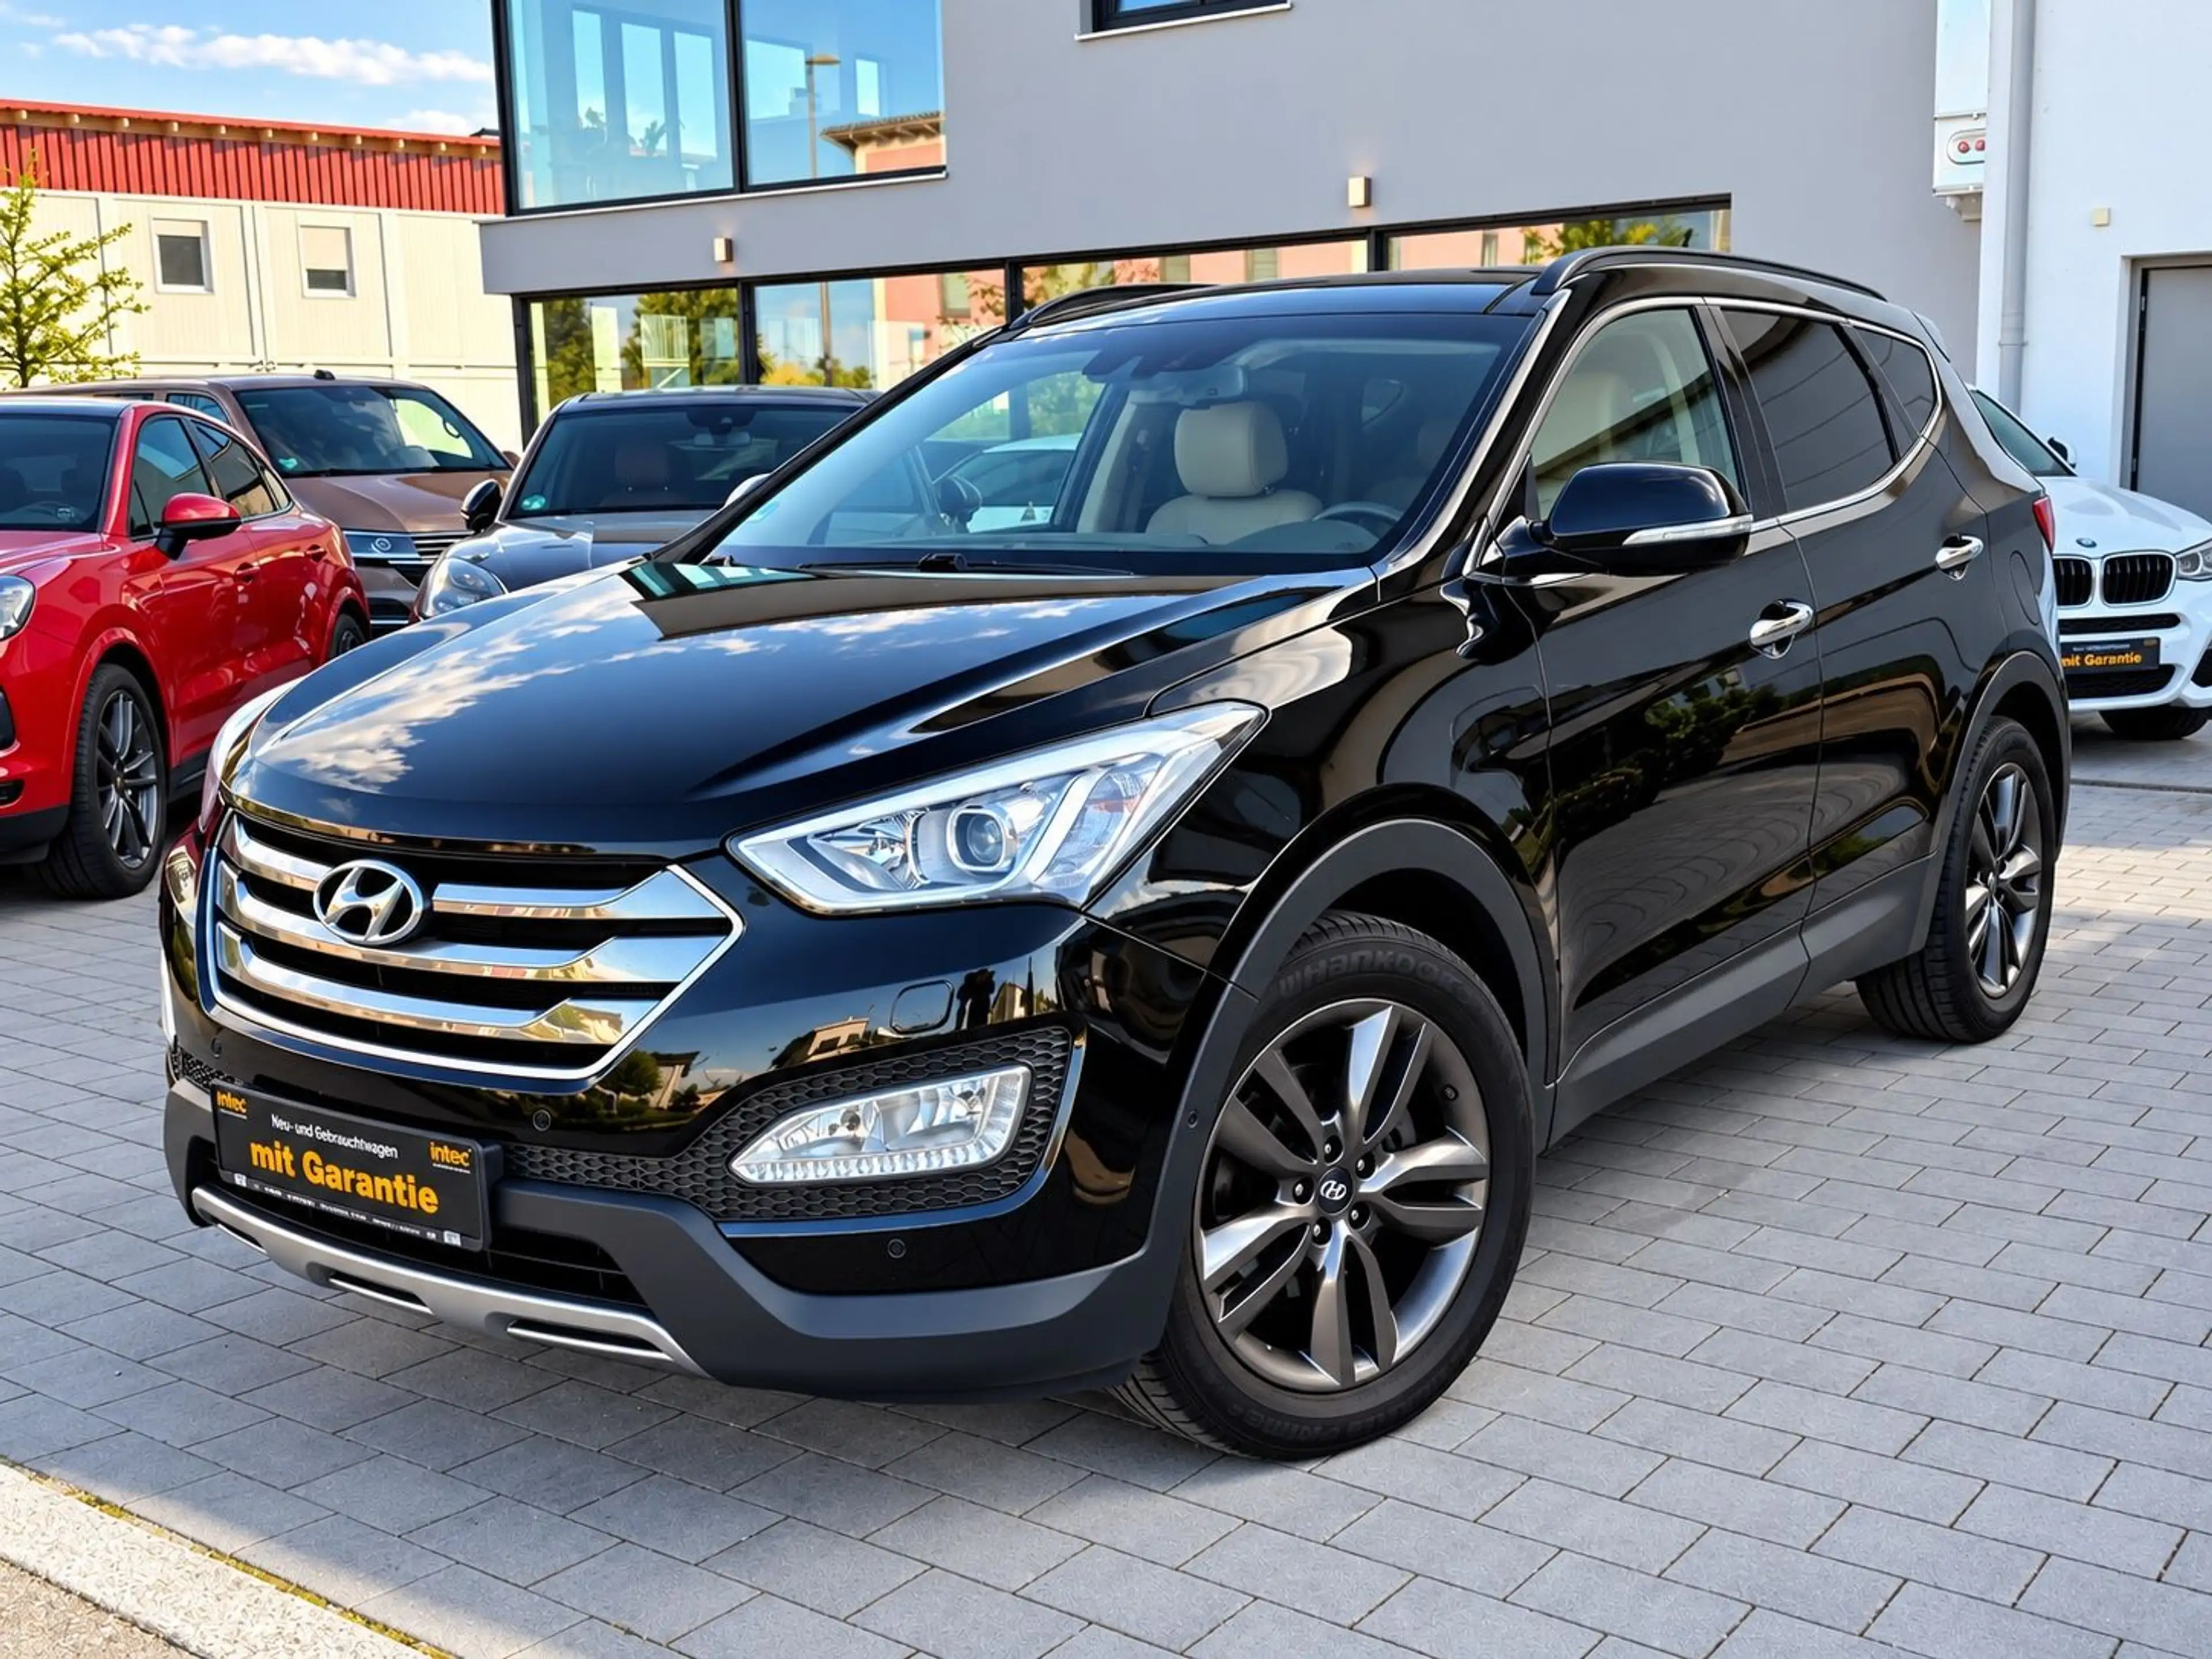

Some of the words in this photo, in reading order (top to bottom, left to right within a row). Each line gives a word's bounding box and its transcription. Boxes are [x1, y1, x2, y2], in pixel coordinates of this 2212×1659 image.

[2084, 652, 2142, 666] Garantie
[216, 1090, 247, 1114] intec
[271, 1113, 294, 1132] Neu-
[294, 1123, 315, 1138] und
[315, 1125, 398, 1159] Gebrauchtwagen
[429, 1141, 470, 1168] intec
[249, 1139, 296, 1179] mit
[302, 1150, 439, 1214] Garantie
